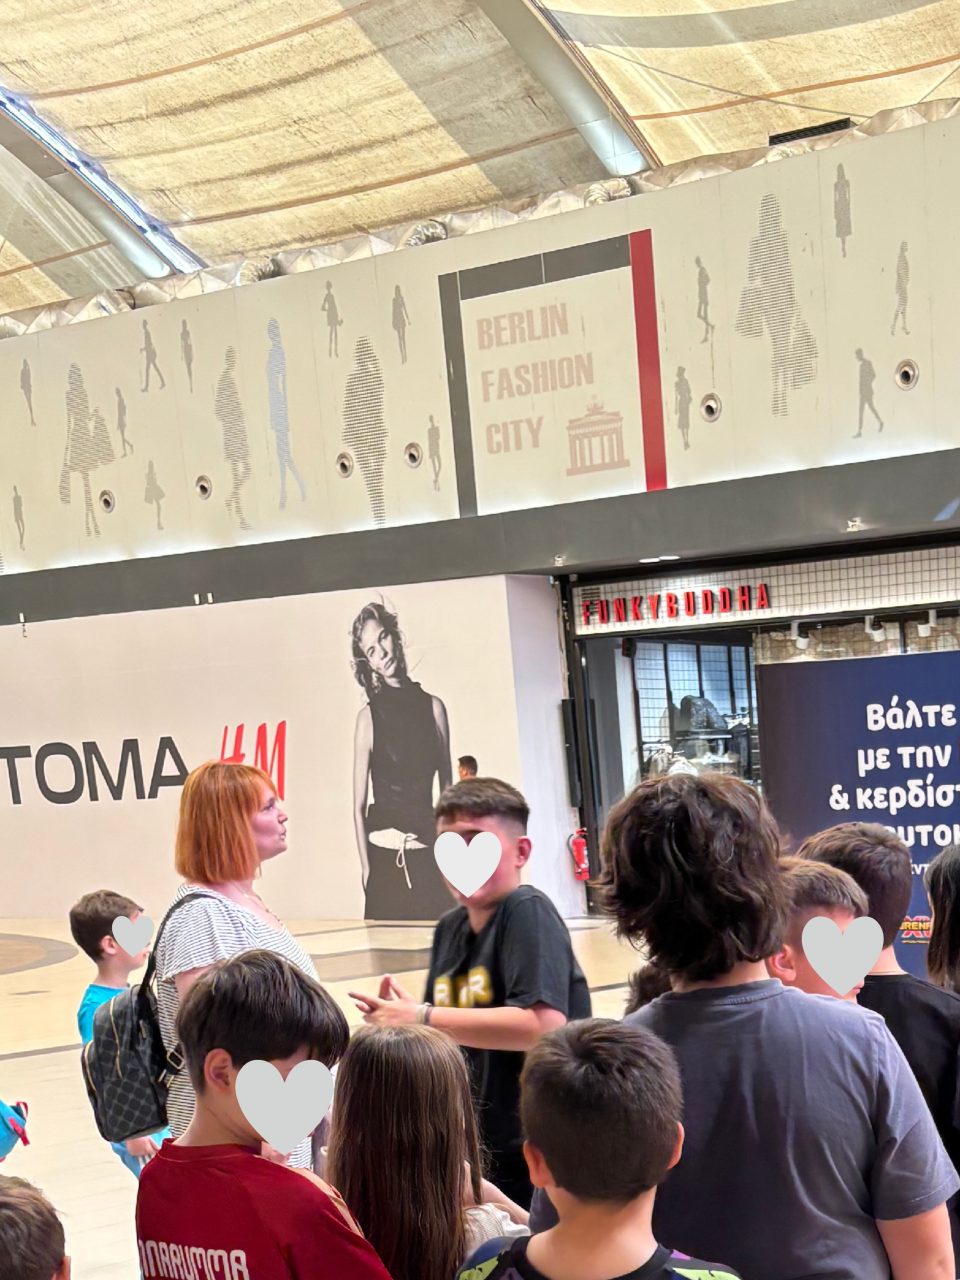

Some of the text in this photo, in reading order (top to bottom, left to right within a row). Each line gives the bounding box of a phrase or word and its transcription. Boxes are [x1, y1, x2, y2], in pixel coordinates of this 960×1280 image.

[477, 303, 569, 350] BERLIN
[481, 352, 595, 402] FASHION
[485, 416, 544, 454] CITY
[581, 582, 770, 626] FUNKYBUDDHA
[866, 695, 956, 731] Βάλτε
[857, 747, 891, 777] με
[897, 745, 952, 768] την
[829, 784, 850, 811] &
